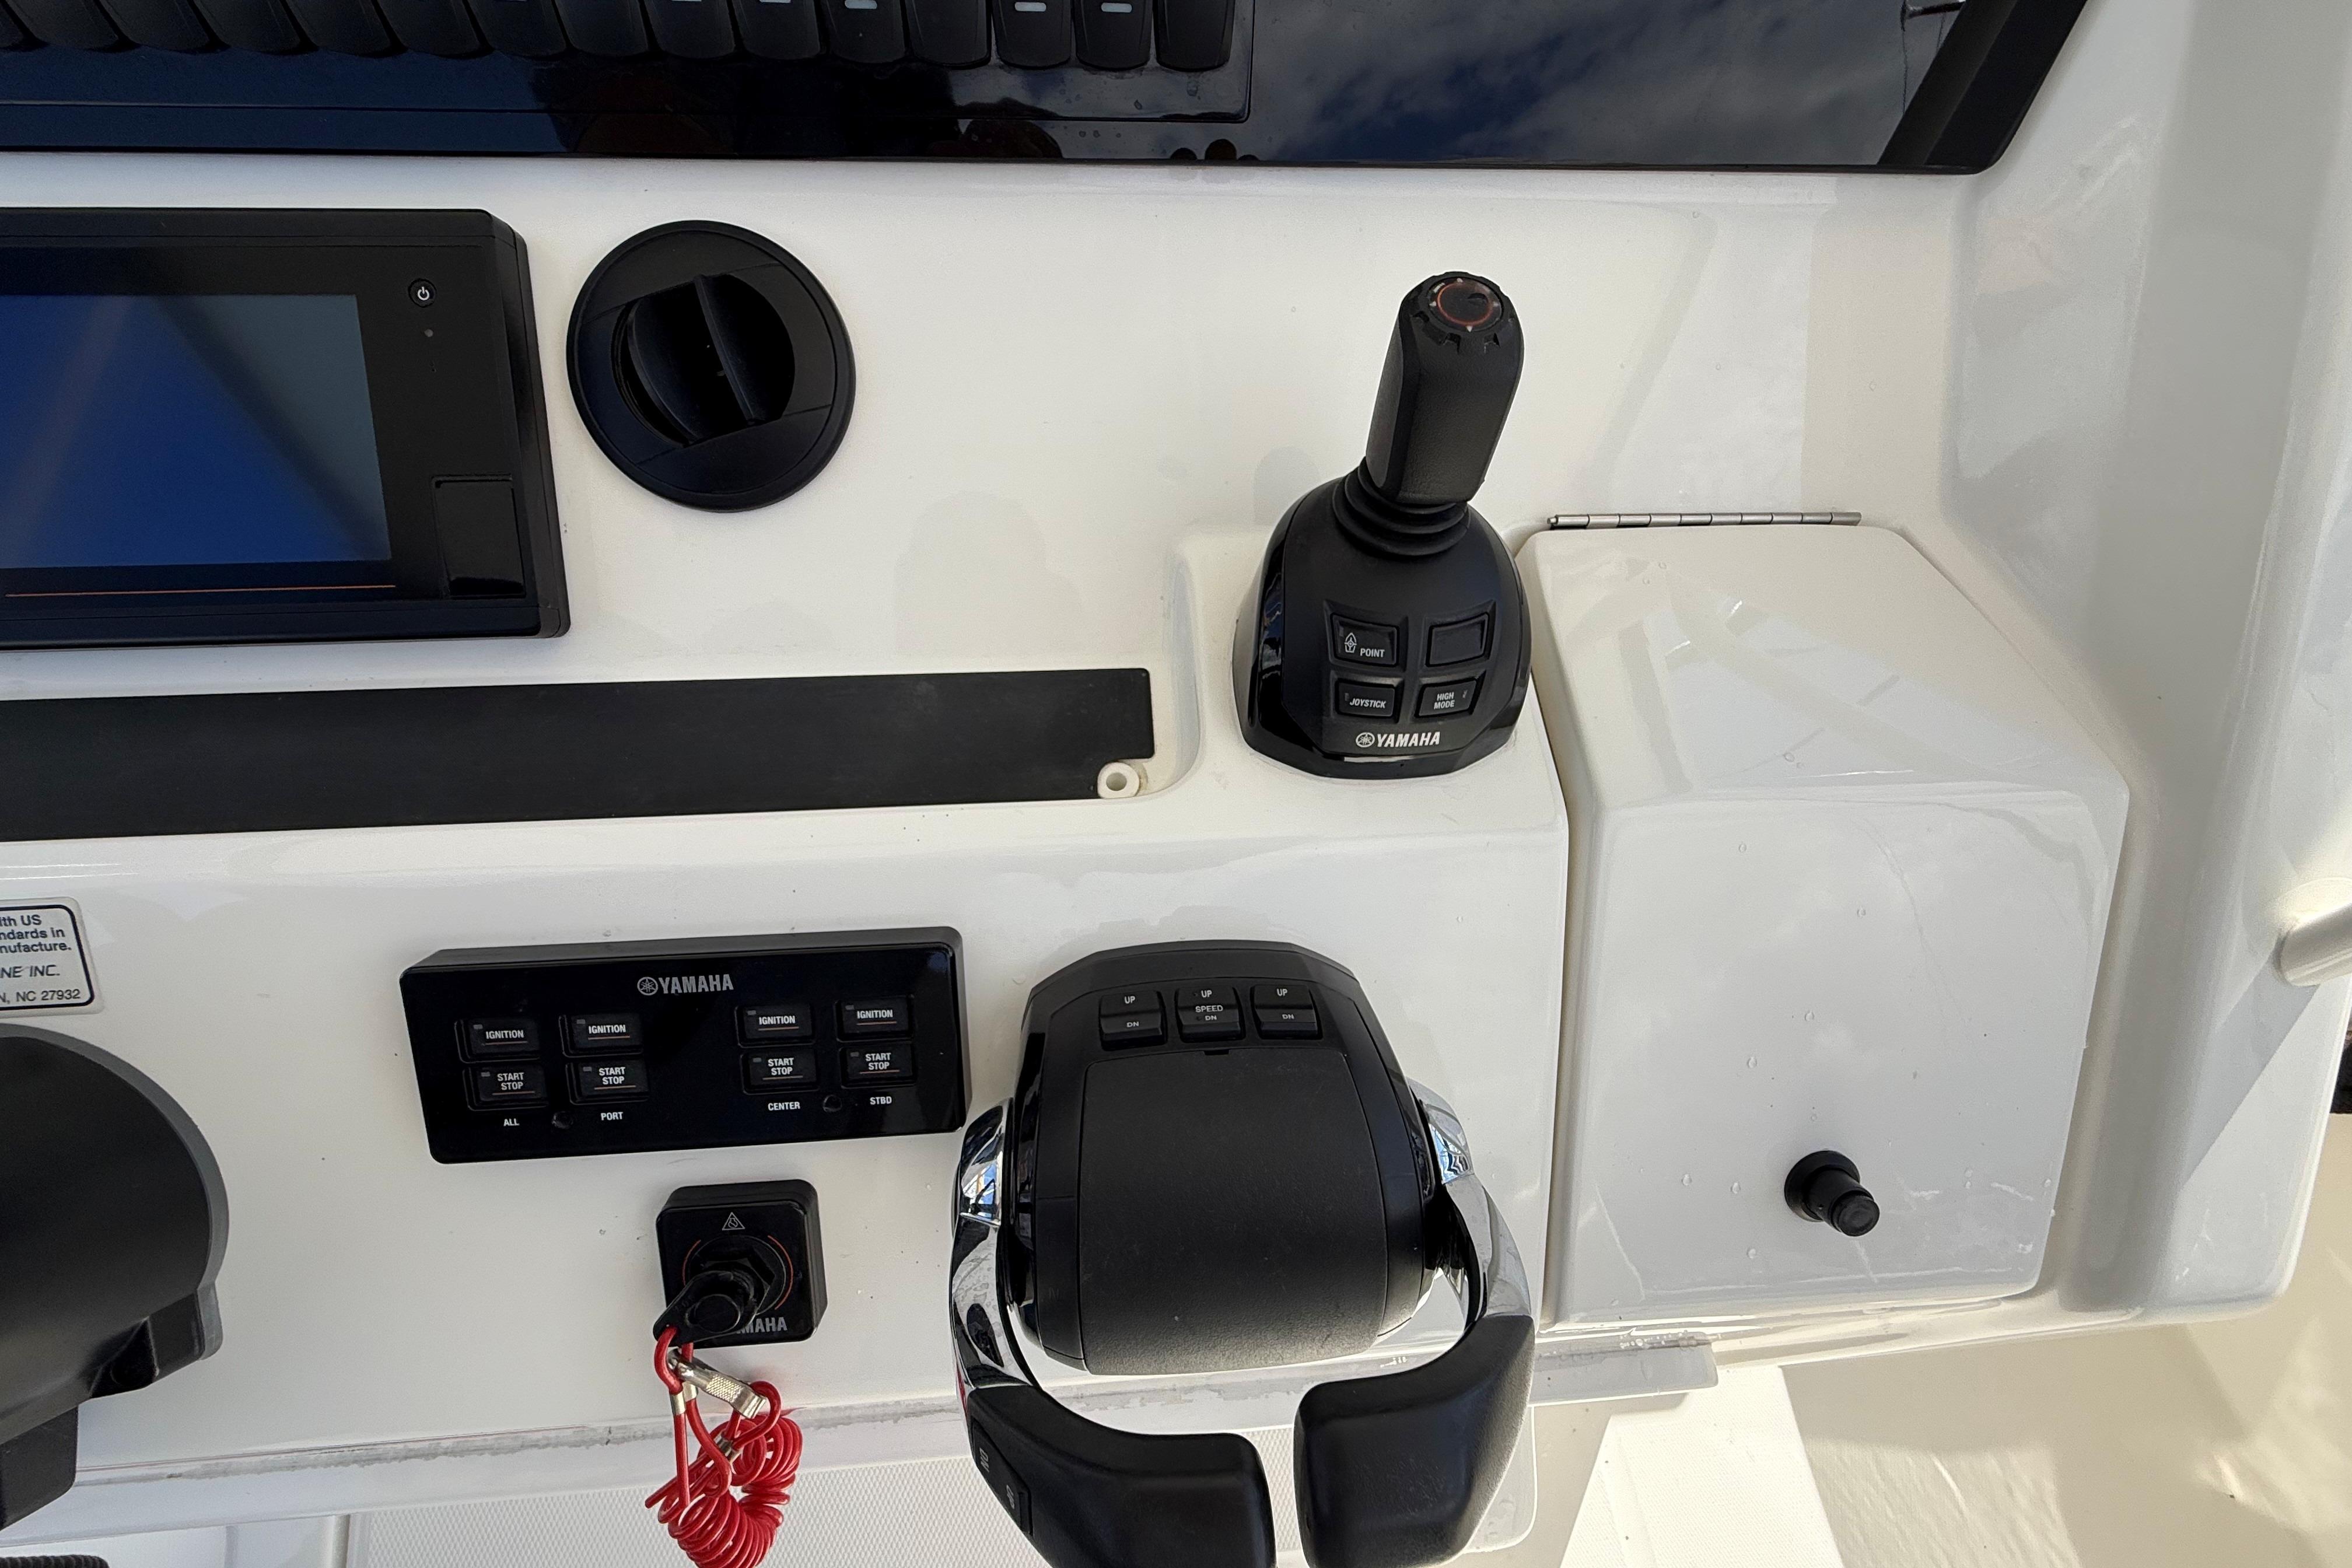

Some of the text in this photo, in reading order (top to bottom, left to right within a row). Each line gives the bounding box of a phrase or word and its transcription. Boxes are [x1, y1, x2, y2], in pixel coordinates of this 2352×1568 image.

[1360, 648, 1385, 658] POINT
[1436, 692, 1455, 701] HIGH
[1349, 698, 1387, 709] JOYSTICK
[1433, 701, 1455, 709] MODE
[1377, 731, 1440, 748] YAMAHA
[20, 914, 42, 926] US
[51, 927, 65, 938] in
[29, 964, 60, 977] INC.
[659, 974, 734, 993] YAMAHA
[16, 991, 37, 1002] NC
[41, 989, 81, 1001] 27932
[1200, 990, 1212, 998] UP
[1276, 988, 1288, 996] UP
[1124, 996, 1136, 1004] UP
[857, 1009, 893, 1019] IGNITION
[1195, 1005, 1223, 1013] SPEED
[758, 1015, 796, 1025] IGNITION
[588, 1024, 626, 1034] IGNITION
[485, 1030, 524, 1040] IGNITION
[865, 1052, 891, 1062] START
[768, 1058, 794, 1067] START
[868, 1061, 890, 1070] STOP
[598, 1066, 626, 1076] START
[771, 1066, 793, 1076] STOP
[497, 1072, 524, 1082] START
[602, 1076, 625, 1085] STOP
[501, 1082, 524, 1090] STOP
[870, 1096, 892, 1105] STBD
[768, 1101, 800, 1111] CENTER
[600, 1111, 624, 1121] PORT
[503, 1118, 520, 1126] ALL
[736, 1317, 788, 1334] MAHA
[979, 1447, 990, 1474] DN
